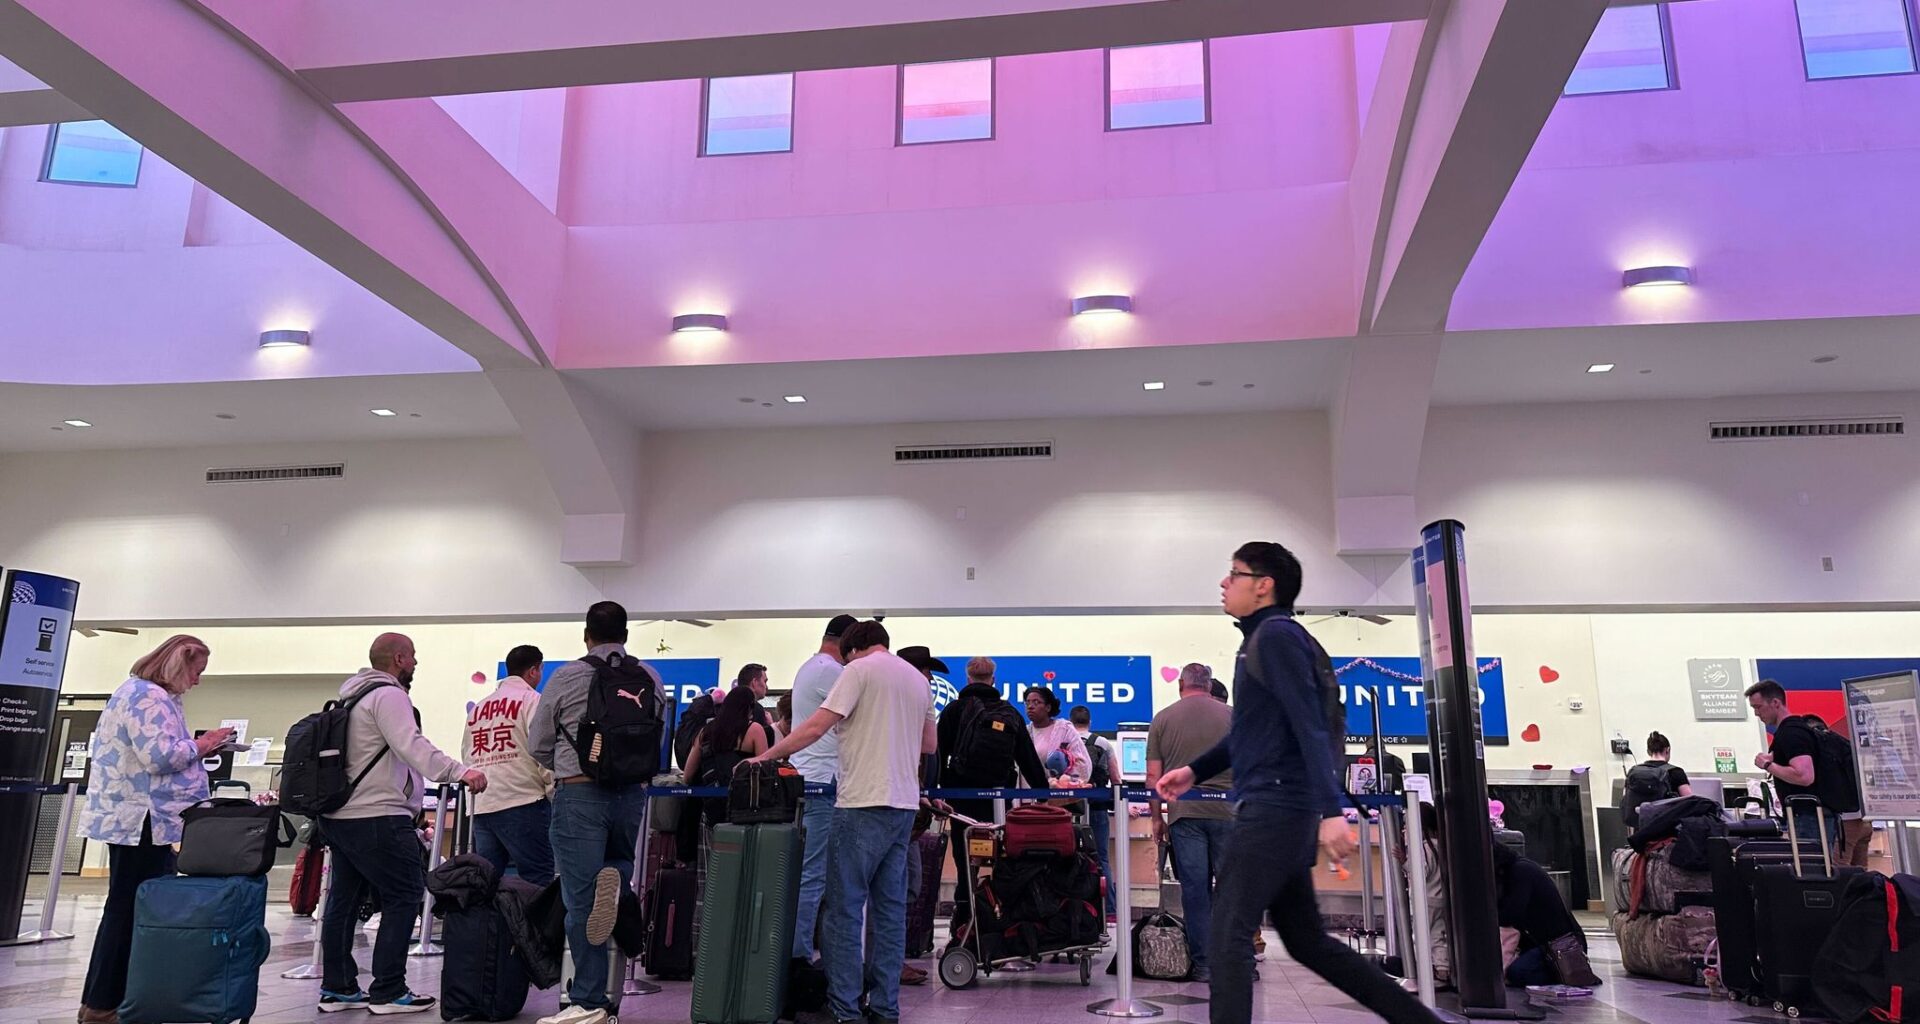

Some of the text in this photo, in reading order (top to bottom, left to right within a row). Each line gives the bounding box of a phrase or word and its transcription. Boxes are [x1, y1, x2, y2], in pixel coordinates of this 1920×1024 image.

[2, 697, 22, 705] Check
[1339, 685, 1486, 707] NIT
[0, 715, 14, 723] Drop
[1, 706, 15, 714] Print
[15, 708, 26, 716] bag
[468, 697, 523, 726] JAPAN
[471, 722, 517, 756] 東京
[1358, 736, 1399, 744] ANCE
[589, 732, 602, 763] PUMA
